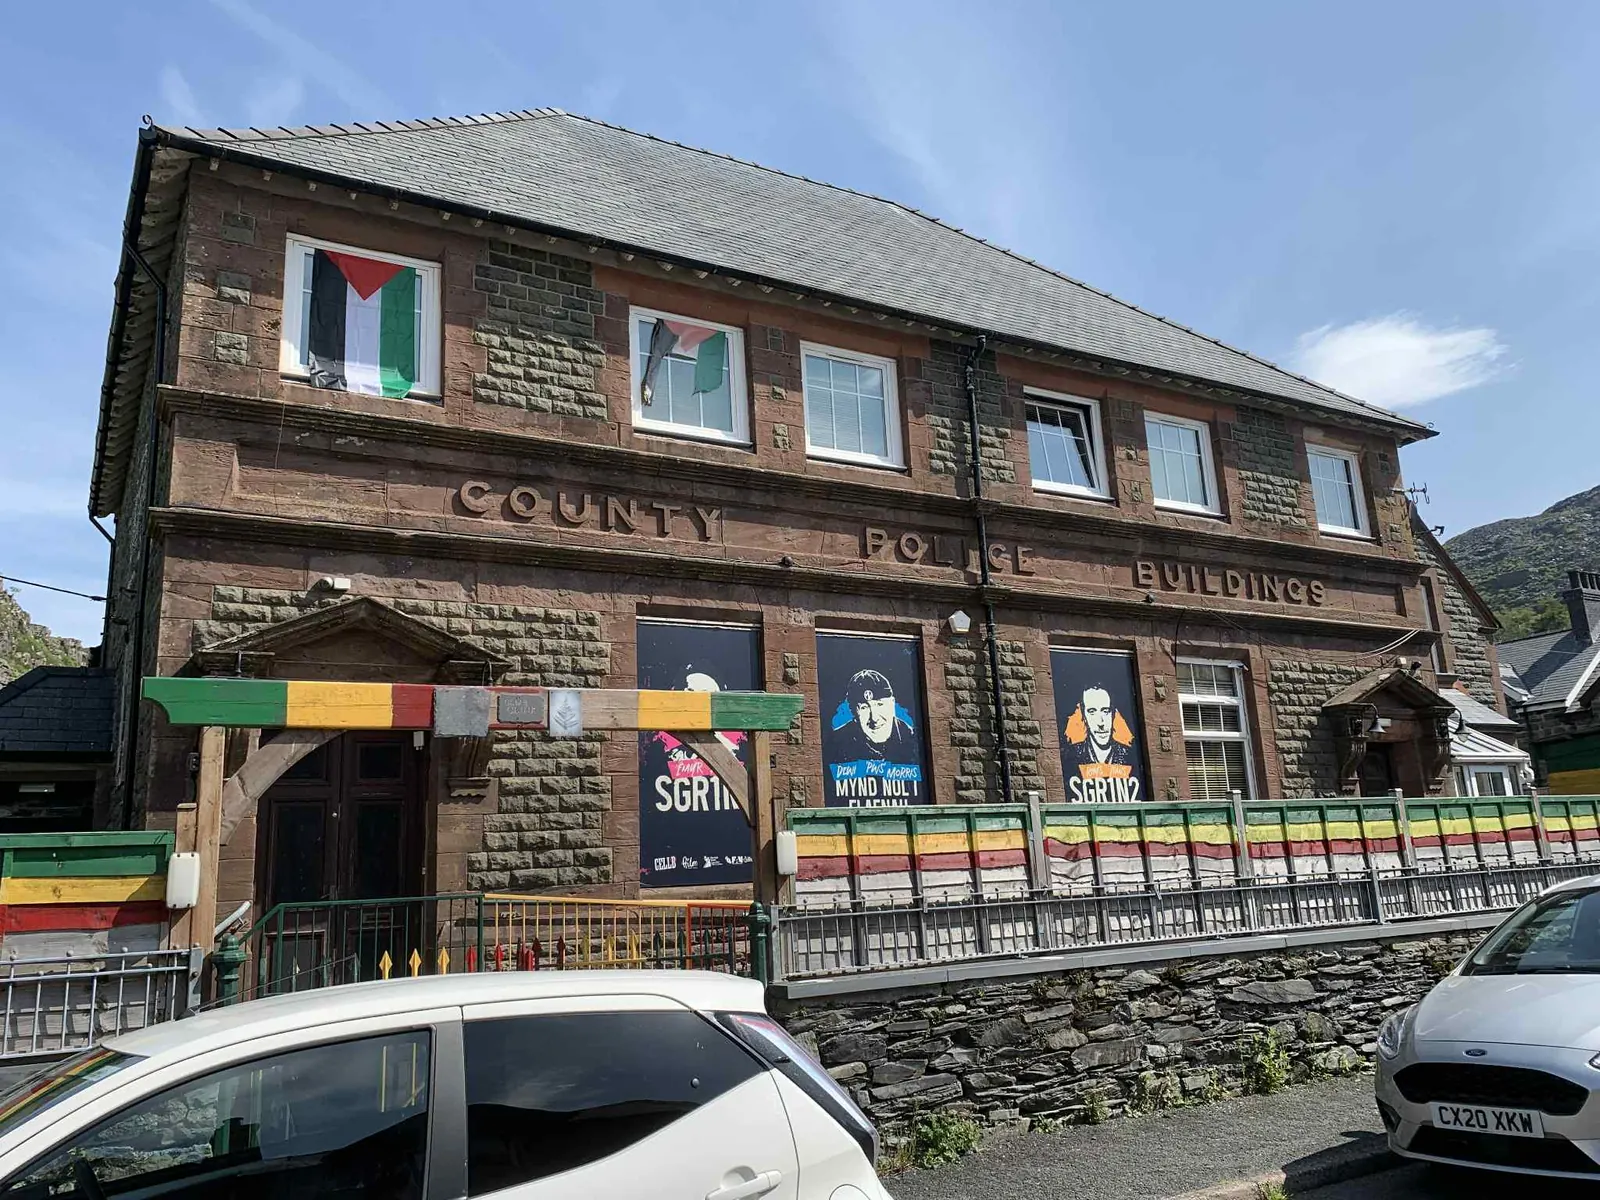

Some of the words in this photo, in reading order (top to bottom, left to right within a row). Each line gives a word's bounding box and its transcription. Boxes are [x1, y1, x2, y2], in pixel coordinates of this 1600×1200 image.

[460, 480, 721, 539] COUNTY
[866, 527, 1035, 573] POLICE
[1136, 561, 1327, 603] BUILDINGS
[886, 767, 918, 779] MORRIS
[836, 777, 877, 797] MYND
[1438, 1106, 1488, 1129] CX20
[1492, 1110, 1534, 1133] XKW
